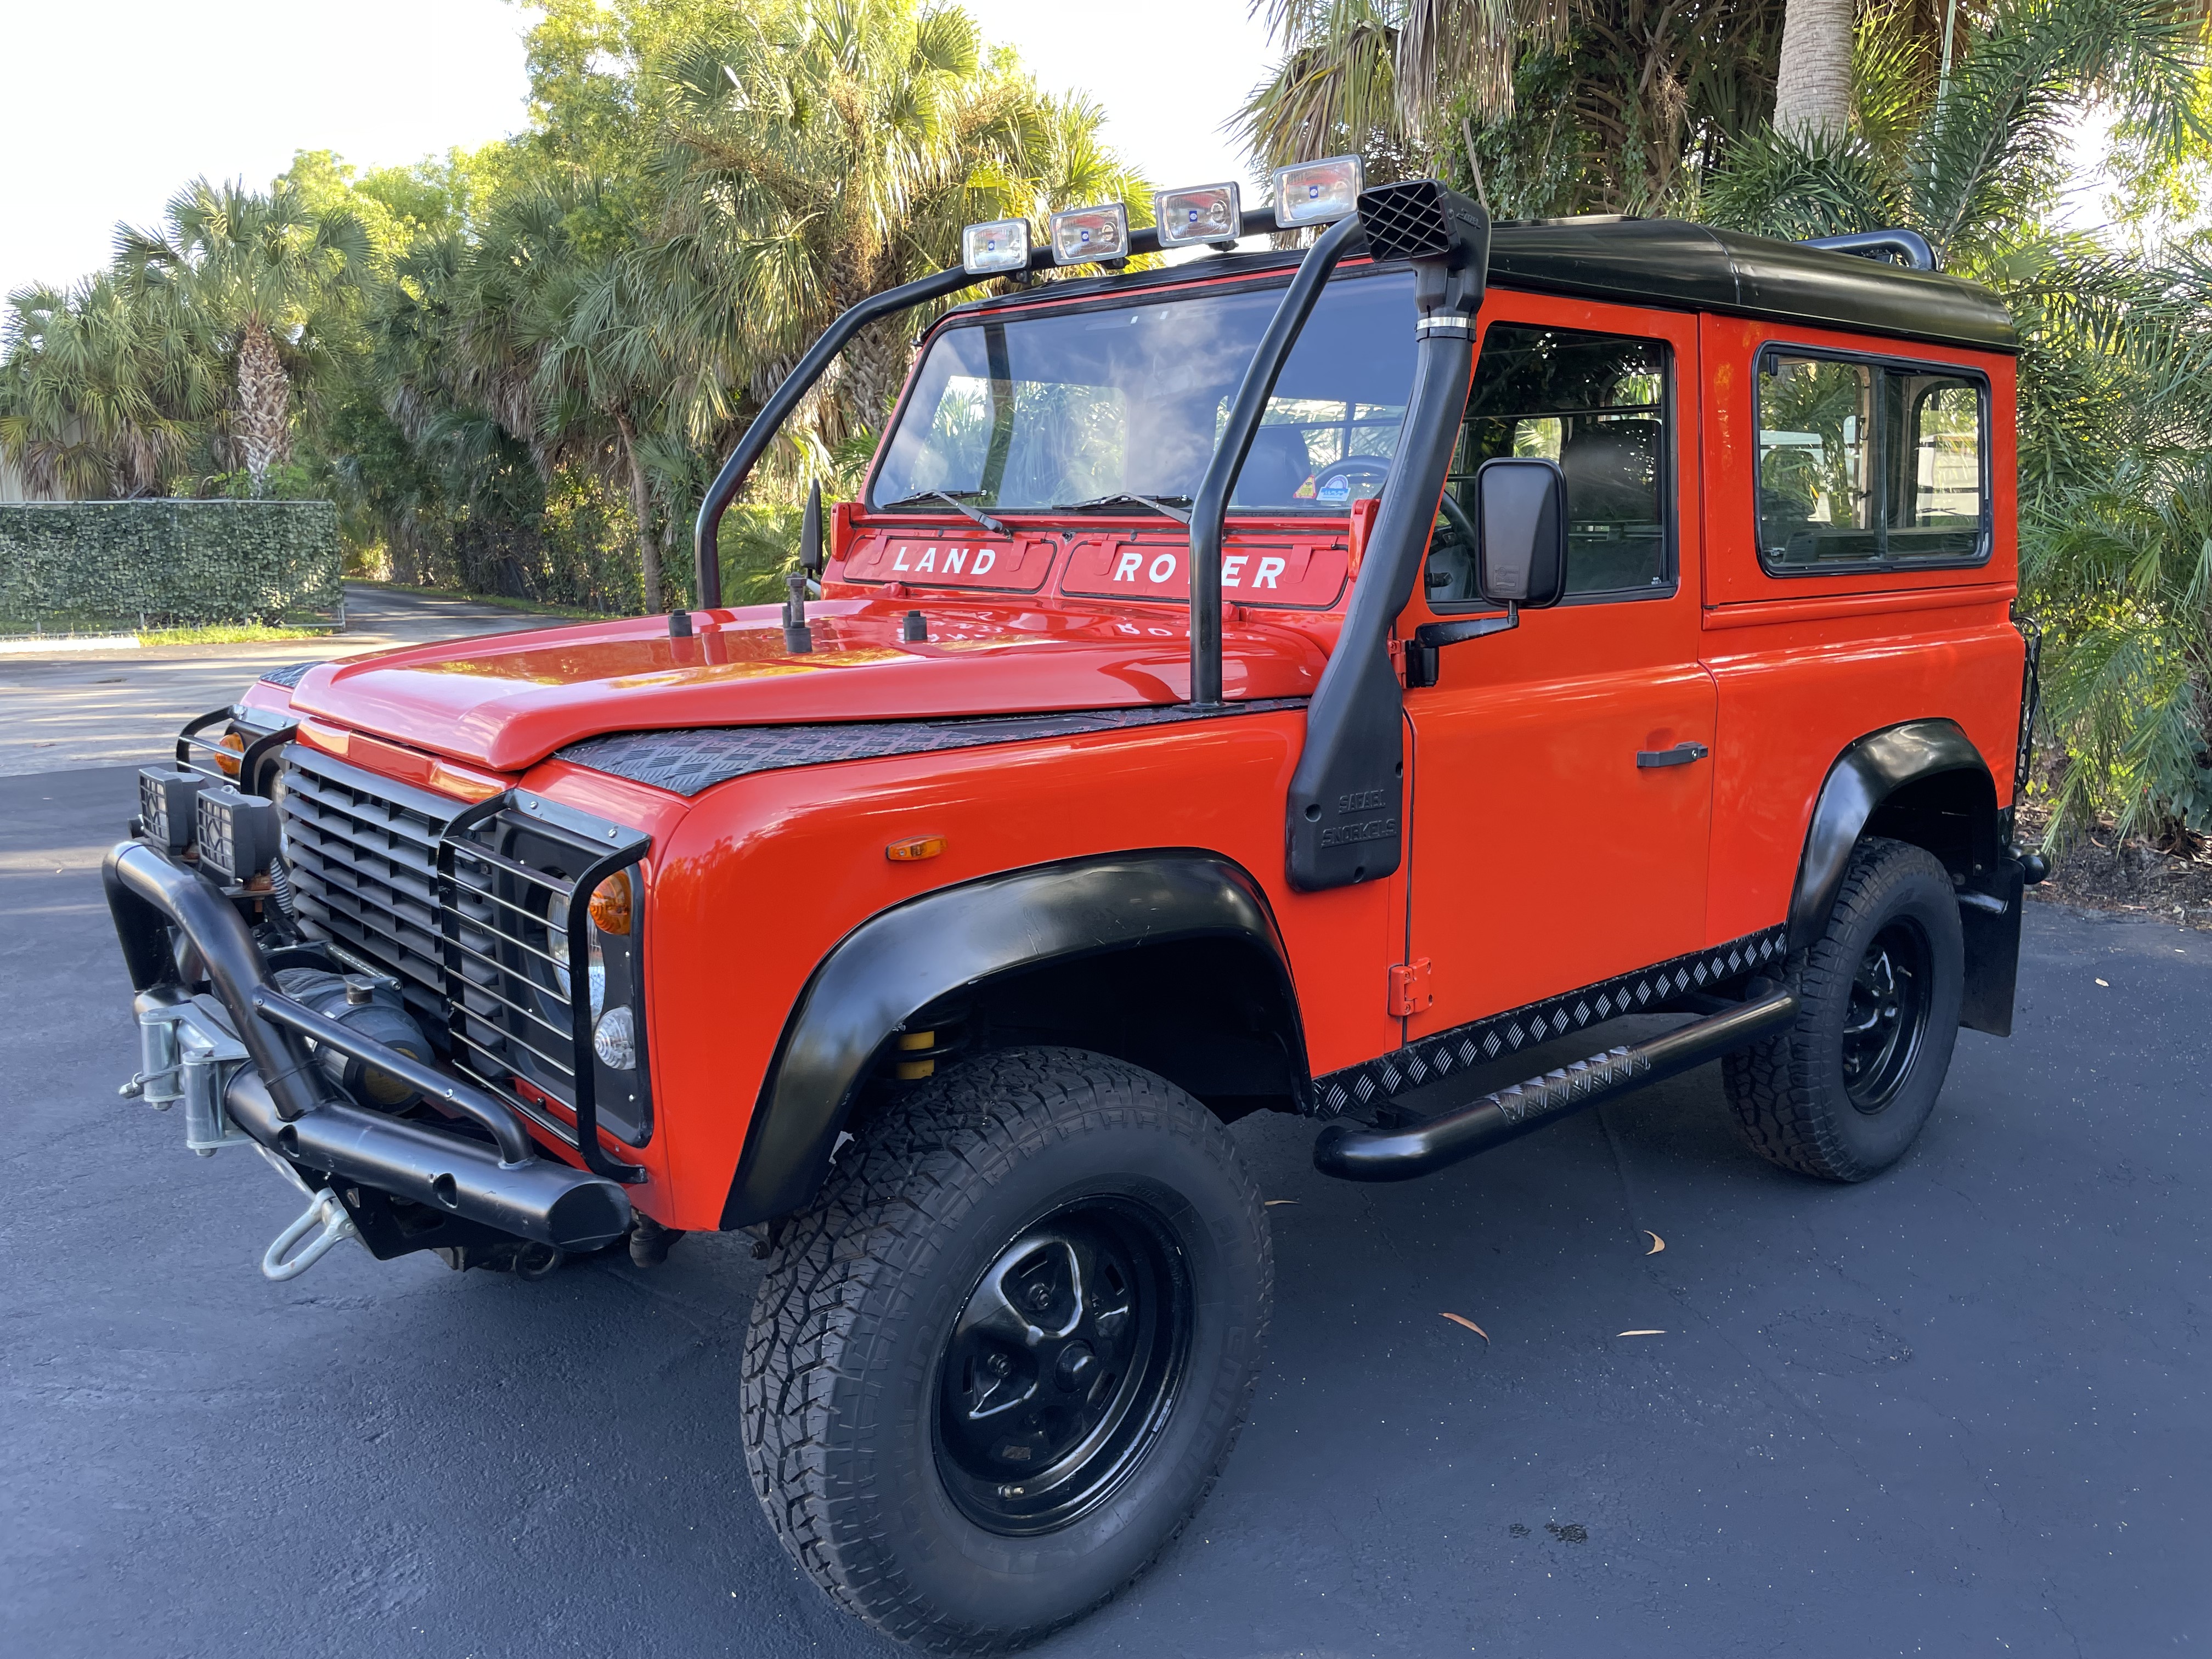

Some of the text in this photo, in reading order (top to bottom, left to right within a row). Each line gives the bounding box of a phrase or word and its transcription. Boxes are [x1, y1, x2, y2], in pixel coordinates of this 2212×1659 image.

[892, 546, 1285, 589] LAND ROER
[1339, 789, 1386, 813] SAFARI
[1322, 818, 1397, 847] SNORKELS
